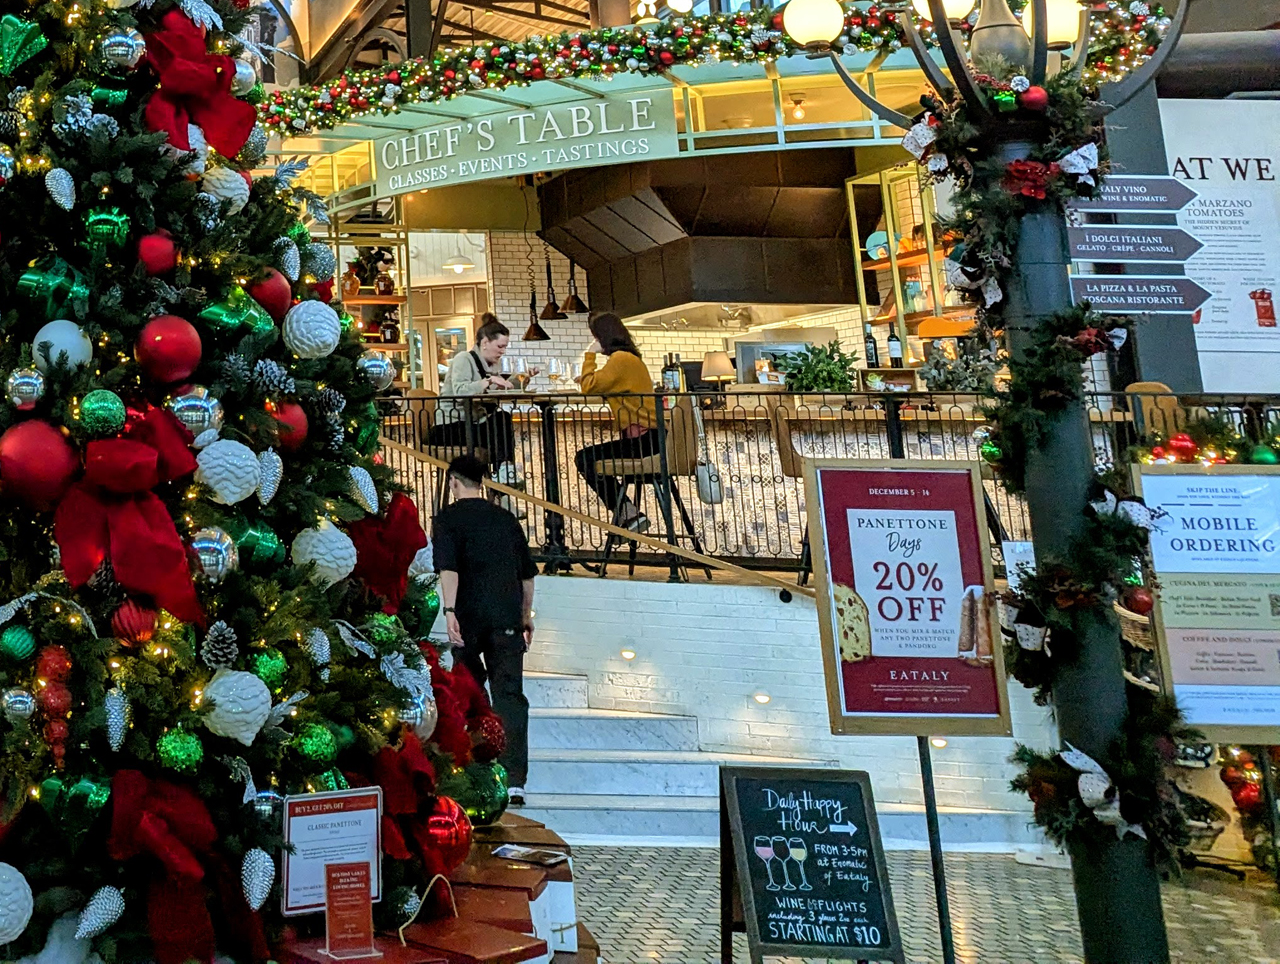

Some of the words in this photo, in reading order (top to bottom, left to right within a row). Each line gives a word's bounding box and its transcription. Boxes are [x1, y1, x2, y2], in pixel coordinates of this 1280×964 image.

[381, 118, 496, 171] CHEF'S
[507, 97, 657, 146] TABLE
[389, 168, 448, 191] CLASSES
[458, 151, 528, 178] EVENTS
[541, 138, 651, 165] TASTINGS
[1172, 156, 1213, 181] AT
[1100, 186, 1122, 194] TALY
[1123, 186, 1148, 194] VINO
[1129, 195, 1169, 203] ENOMATIC
[1199, 199, 1253, 208] MARZANO
[1185, 209, 1246, 217] TOMATOES
[1091, 235, 1120, 243] DOLCI
[1121, 235, 1163, 244] ITALIANI
[1076, 244, 1107, 252] GELATO
[1139, 245, 1174, 253] CANNOLI
[1100, 285, 1126, 293] PIZZA
[1150, 286, 1178, 294] PASTA
[1082, 296, 1126, 304] TOSCANA
[1127, 296, 1185, 305] RISTORANTE
[868, 488, 909, 496] DECEMBER
[856, 517, 949, 530] PANETTONE
[1180, 517, 1259, 531] MOBILE
[885, 531, 922, 558] Days
[1170, 537, 1276, 553] ORDERING
[872, 561, 944, 592] 20%
[877, 596, 947, 622] OFF
[889, 670, 950, 681] EATALY
[761, 788, 802, 821] Daily
[800, 790, 848, 823] Happy
[307, 822, 330, 831] CLASSIC
[330, 819, 363, 829] PANETTONE
[814, 844, 840, 856] FROM
[817, 858, 829, 868] at
[831, 857, 868, 869] Enomatic
[835, 871, 873, 891] Eataly
[775, 897, 806, 910] WINE
[818, 899, 867, 913] FLIGHTS
[768, 921, 835, 944] STARTING
[835, 926, 851, 944] AT
[853, 926, 881, 945] $10
